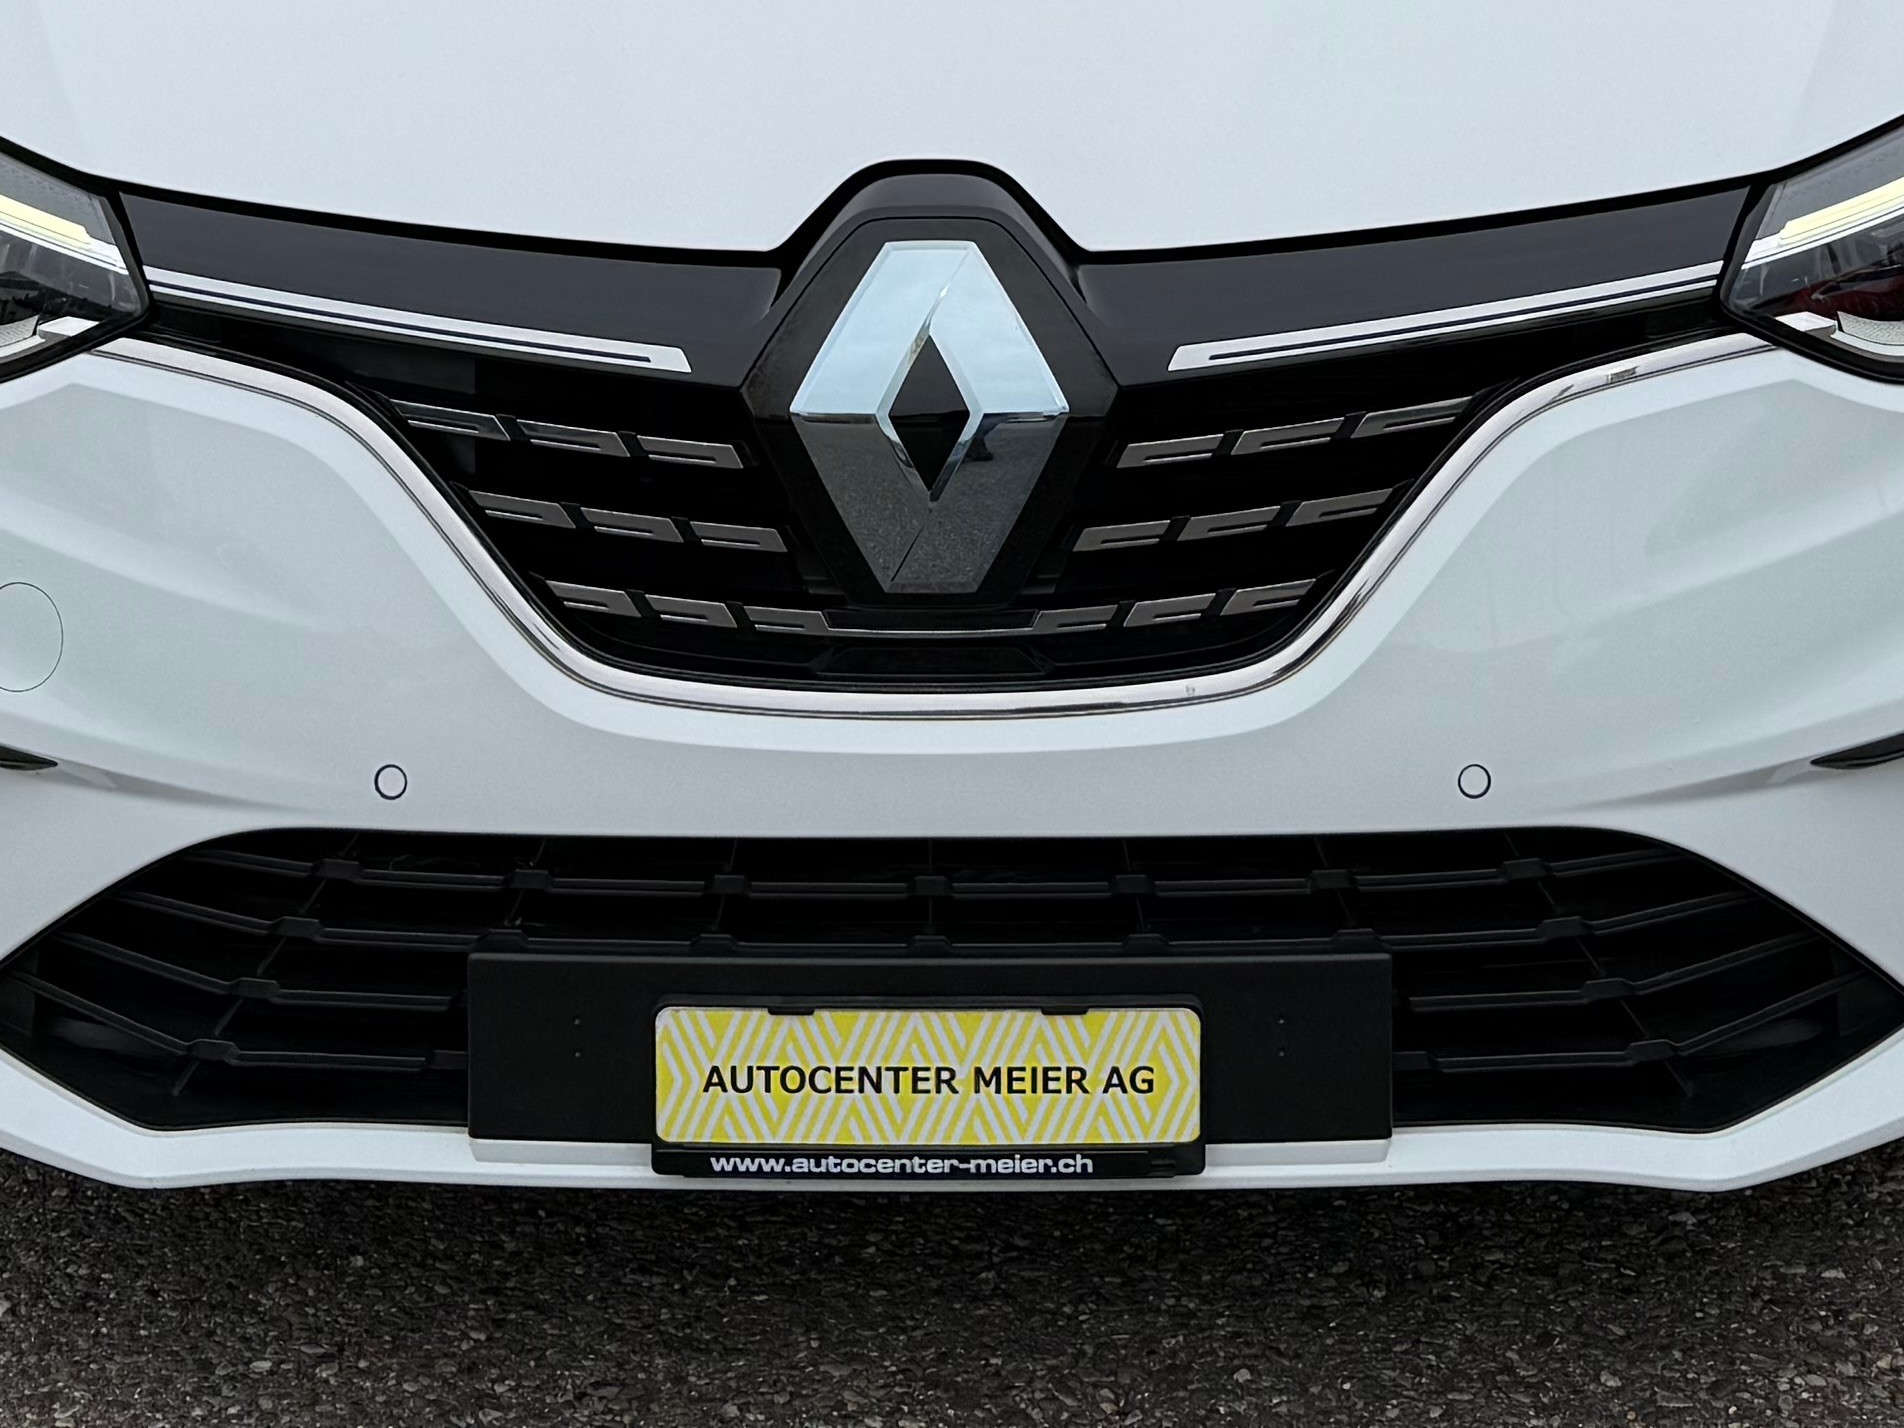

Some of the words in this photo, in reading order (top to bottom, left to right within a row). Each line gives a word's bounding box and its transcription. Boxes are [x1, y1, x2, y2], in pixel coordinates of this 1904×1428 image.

[702, 1064, 959, 1095] AUTOCENTER
[973, 1065, 1090, 1095] MEIER
[1102, 1065, 1155, 1094] AG
[710, 1154, 1094, 1175] www.autocenter-meier.ch
